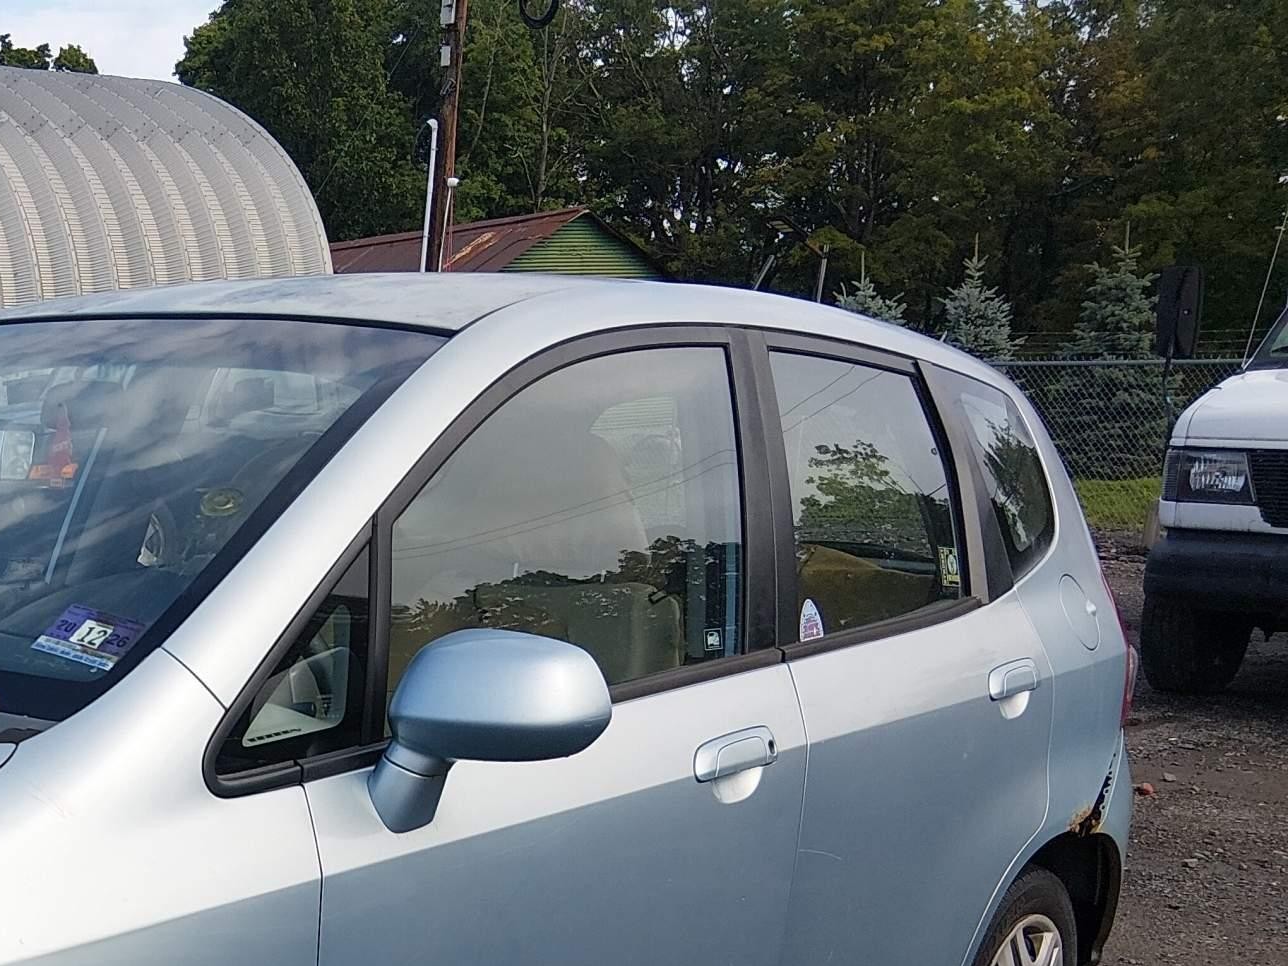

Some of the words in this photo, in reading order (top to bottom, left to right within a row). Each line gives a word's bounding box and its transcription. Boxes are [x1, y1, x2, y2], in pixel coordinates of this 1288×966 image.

[55, 620, 77, 633] 20
[77, 626, 108, 646] 12
[106, 633, 130, 648] 26
